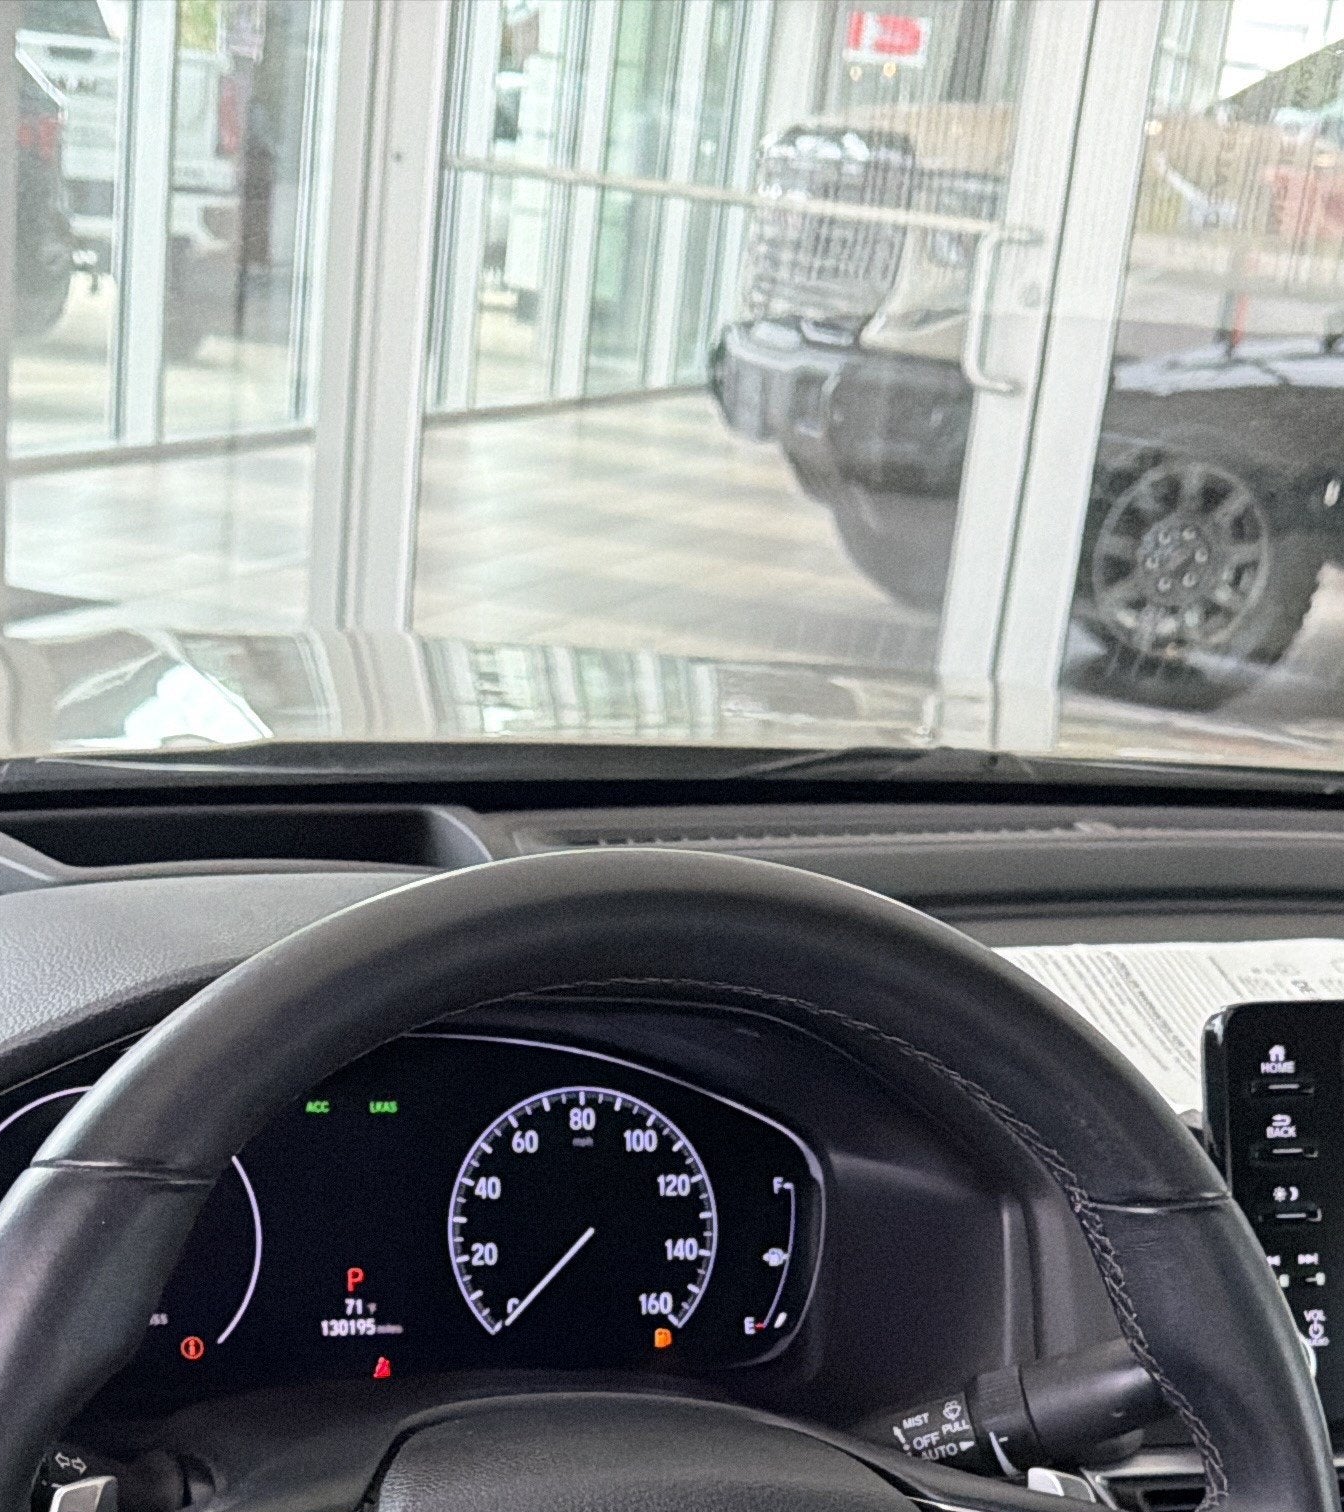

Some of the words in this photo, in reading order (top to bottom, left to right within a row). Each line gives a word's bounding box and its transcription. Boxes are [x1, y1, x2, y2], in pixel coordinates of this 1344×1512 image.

[1260, 1061, 1295, 1074] HOME
[569, 1107, 596, 1130] 80
[623, 1130, 658, 1152] 100
[1266, 1126, 1297, 1138] BACK
[512, 1131, 539, 1153] 60
[474, 1177, 501, 1199] 40
[657, 1174, 691, 1197] 120
[772, 1177, 784, 1194] F
[471, 1243, 498, 1266] 20
[664, 1238, 698, 1261] 140
[347, 1267, 365, 1292] P
[345, 1298, 363, 1316] 71
[639, 1292, 673, 1315] 160
[320, 1318, 376, 1337] 130195
[744, 1317, 755, 1335] E
[902, 1412, 930, 1429] MIST
[941, 1419, 971, 1435] PULL
[912, 1431, 940, 1450] OFF
[921, 1443, 958, 1460] AUTO
